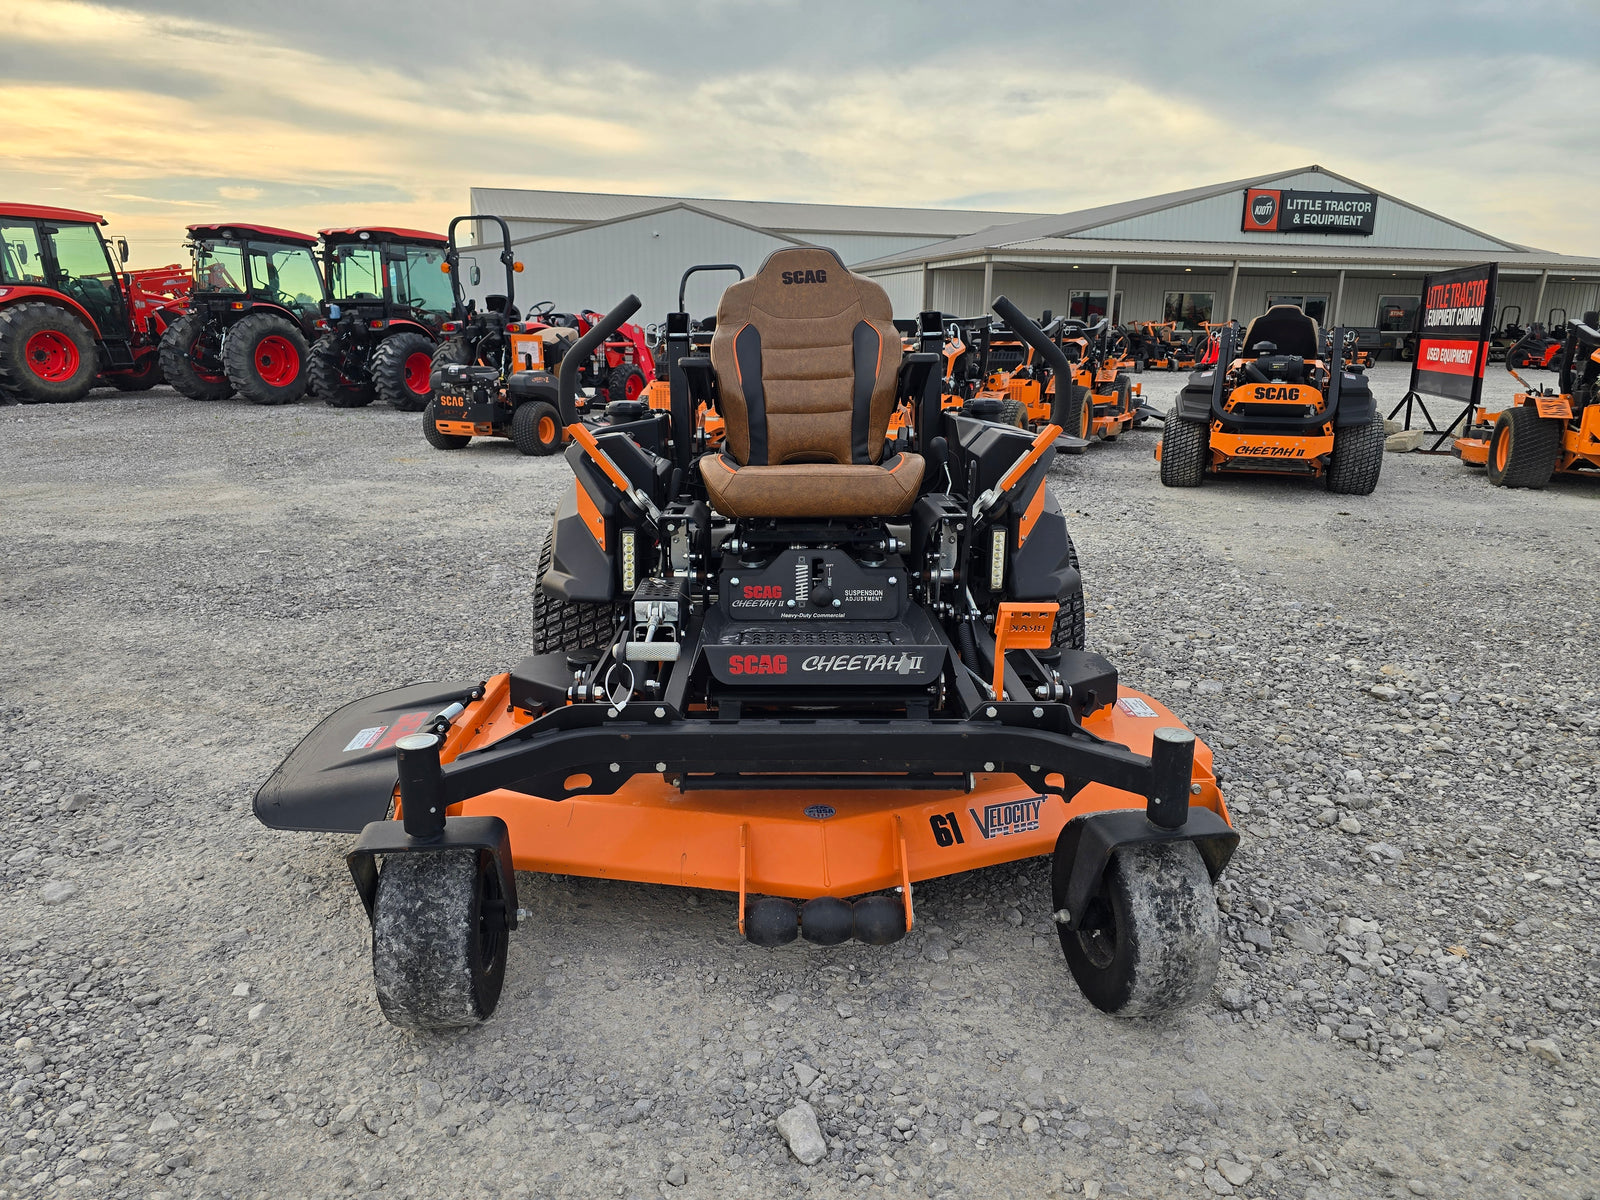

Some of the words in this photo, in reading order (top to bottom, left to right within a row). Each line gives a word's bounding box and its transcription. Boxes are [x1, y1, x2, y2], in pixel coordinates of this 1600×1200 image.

[1287, 199, 1322, 211] LITTLE
[1325, 200, 1372, 212] TRACTOR
[1293, 213, 1301, 224] &
[1303, 213, 1363, 226] EQUIPMENT
[782, 270, 827, 285] SCAG
[1426, 284, 1451, 309] LITTLE
[1427, 308, 1457, 327] EQUIPMENT
[1456, 306, 1485, 326] COMPAN
[1426, 347, 1440, 361] USED
[1440, 348, 1473, 365] EQUIPMENT
[440, 395, 464, 407] SCAG
[1254, 386, 1300, 401] SCAG
[1234, 445, 1296, 457] CHEETAH
[1296, 449, 1306, 457] II
[743, 585, 783, 599] SCAG
[731, 599, 777, 608] CHEETAH
[729, 654, 788, 674] SCAG
[801, 654, 901, 672] CHEETAH
[910, 656, 924, 670] II
[969, 795, 1047, 839] VELOCITY
[929, 811, 965, 848] 61
[989, 820, 1041, 839] PLUS
